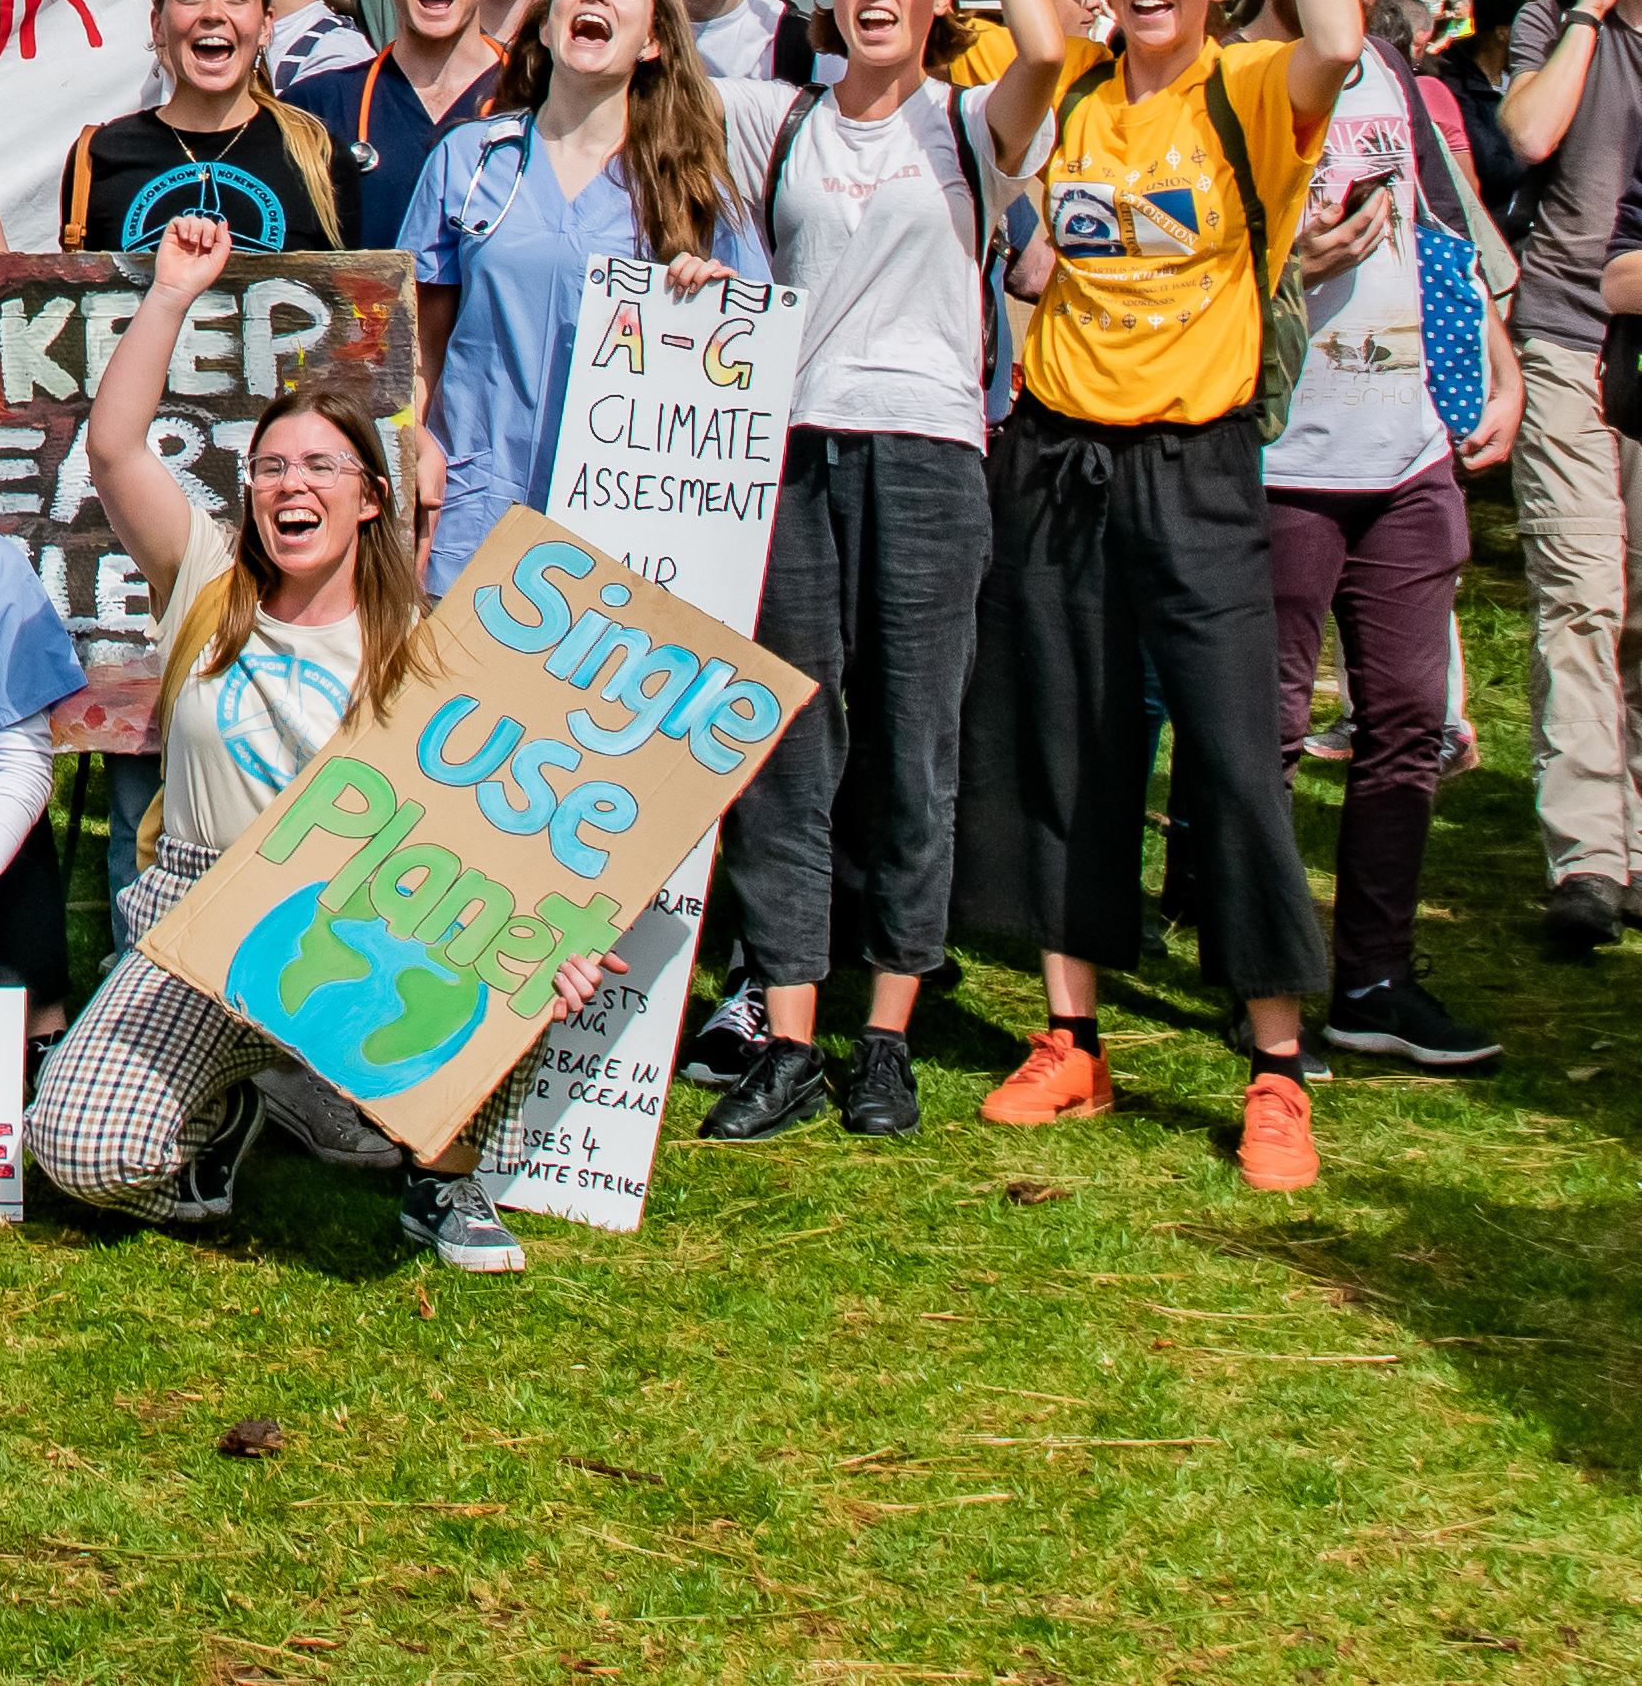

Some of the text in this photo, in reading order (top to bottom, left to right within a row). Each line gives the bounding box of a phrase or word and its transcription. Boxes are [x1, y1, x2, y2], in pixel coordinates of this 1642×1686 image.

[168, 168, 197, 185] NOW
[217, 169, 234, 180] NO
[233, 174, 255, 191] NEW
[142, 181, 167, 207] JOBS
[128, 203, 146, 238] GREEN
[268, 209, 279, 222] OR
[268, 224, 280, 244] GAS
[0, 276, 332, 405] KEEP
[589, 394, 772, 463] CLIMATE
[568, 462, 777, 521] ASSESMENT
[474, 539, 782, 776] Single
[256, 755, 623, 1017] Planet
[632, 1062, 660, 1085] IN
[568, 1080, 660, 1115] OCEANS
[582, 1127, 601, 1162] 4
[577, 1169, 645, 1198] STRIKE
